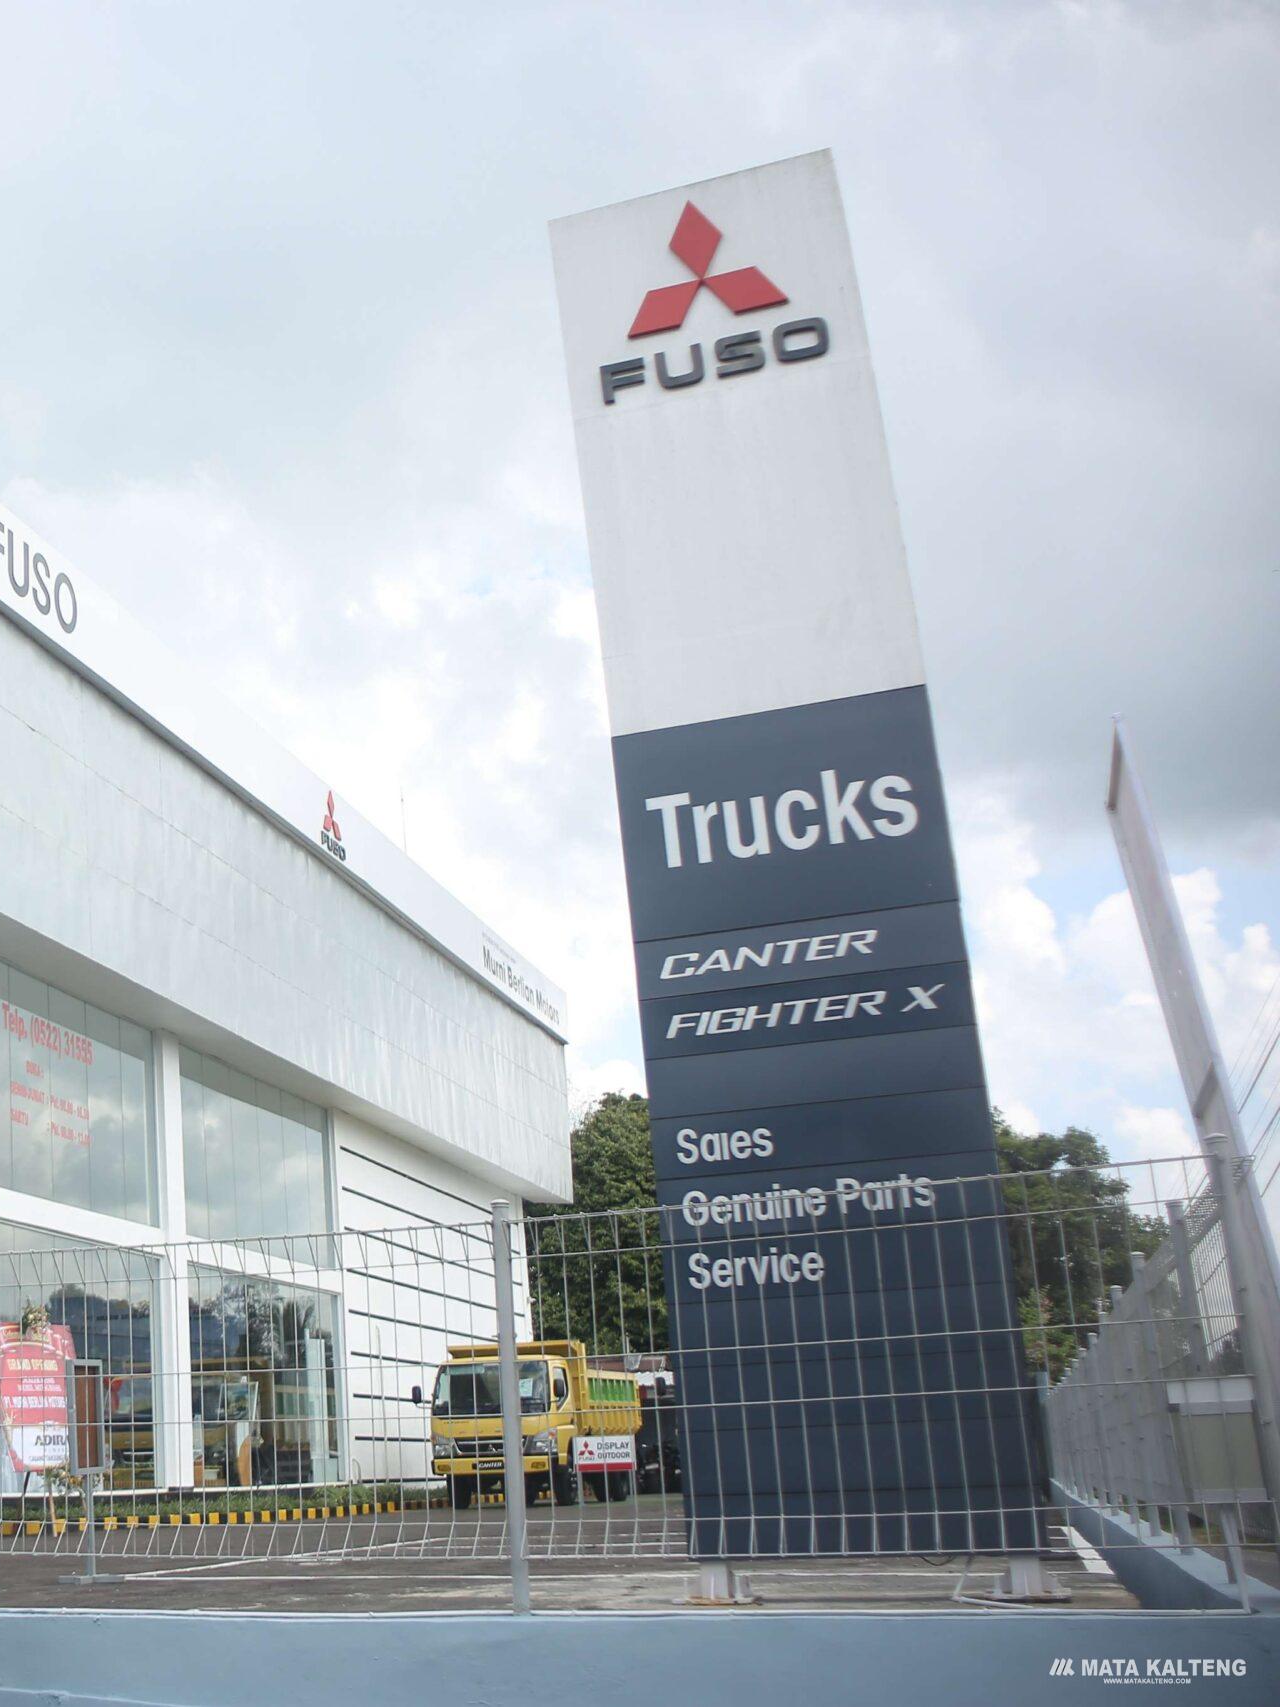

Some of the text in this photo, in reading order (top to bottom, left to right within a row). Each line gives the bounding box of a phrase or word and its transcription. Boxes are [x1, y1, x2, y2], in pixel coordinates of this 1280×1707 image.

[599, 316, 830, 405] FUSO
[645, 769, 919, 869] Trucks
[320, 830, 346, 861] FUSO
[659, 929, 878, 980] CANTER
[482, 945, 507, 984] Murni
[506, 965, 535, 1006] Berlian
[535, 988, 560, 1025] Motors
[1, 1001, 27, 1041] Telp.
[31, 1015, 62, 1059] (0522)
[665, 983, 946, 1039] FIGHTER X
[676, 1127, 775, 1165] Sales
[682, 1174, 936, 1227] Genuine Parts
[687, 1247, 825, 1290] Service
[478, 1461, 503, 1469] CANTER
[596, 1441, 630, 1450] DISPLAY
[597, 1451, 631, 1460] OUTDOOR
